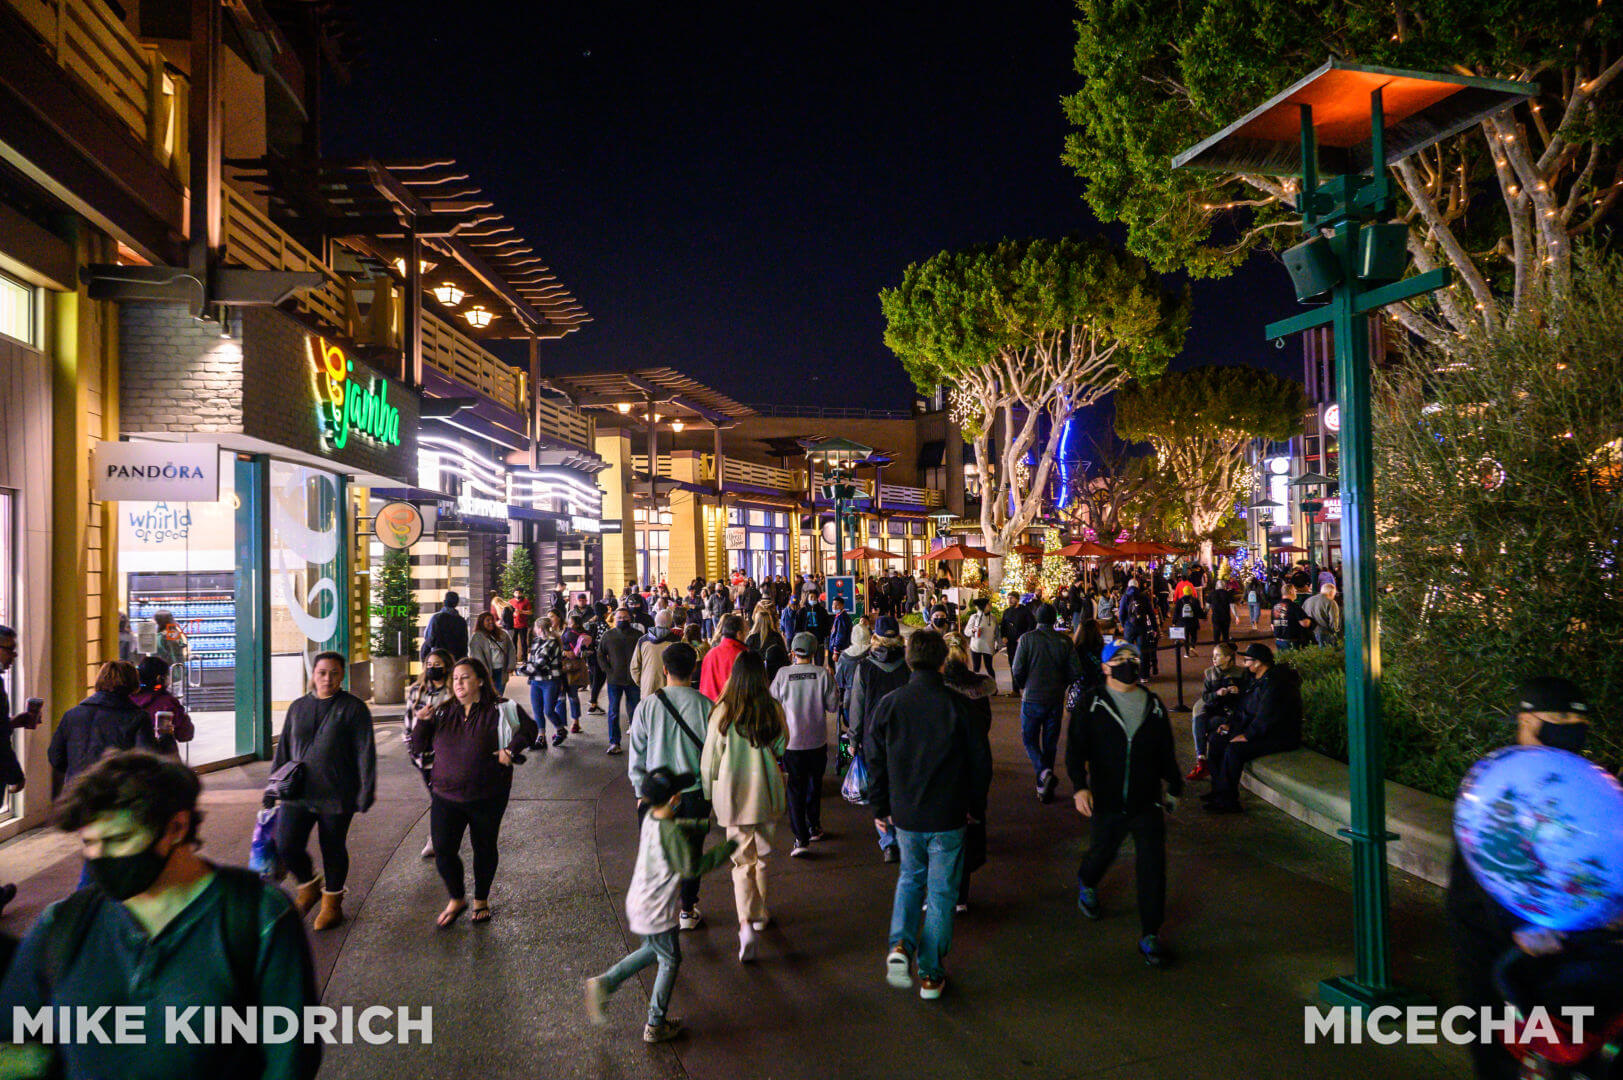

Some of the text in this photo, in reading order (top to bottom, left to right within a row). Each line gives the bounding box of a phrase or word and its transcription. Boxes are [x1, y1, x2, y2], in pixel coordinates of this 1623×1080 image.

[334, 359, 401, 449] jamba
[107, 462, 204, 479] PANDORA
[135, 528, 189, 543] of good
